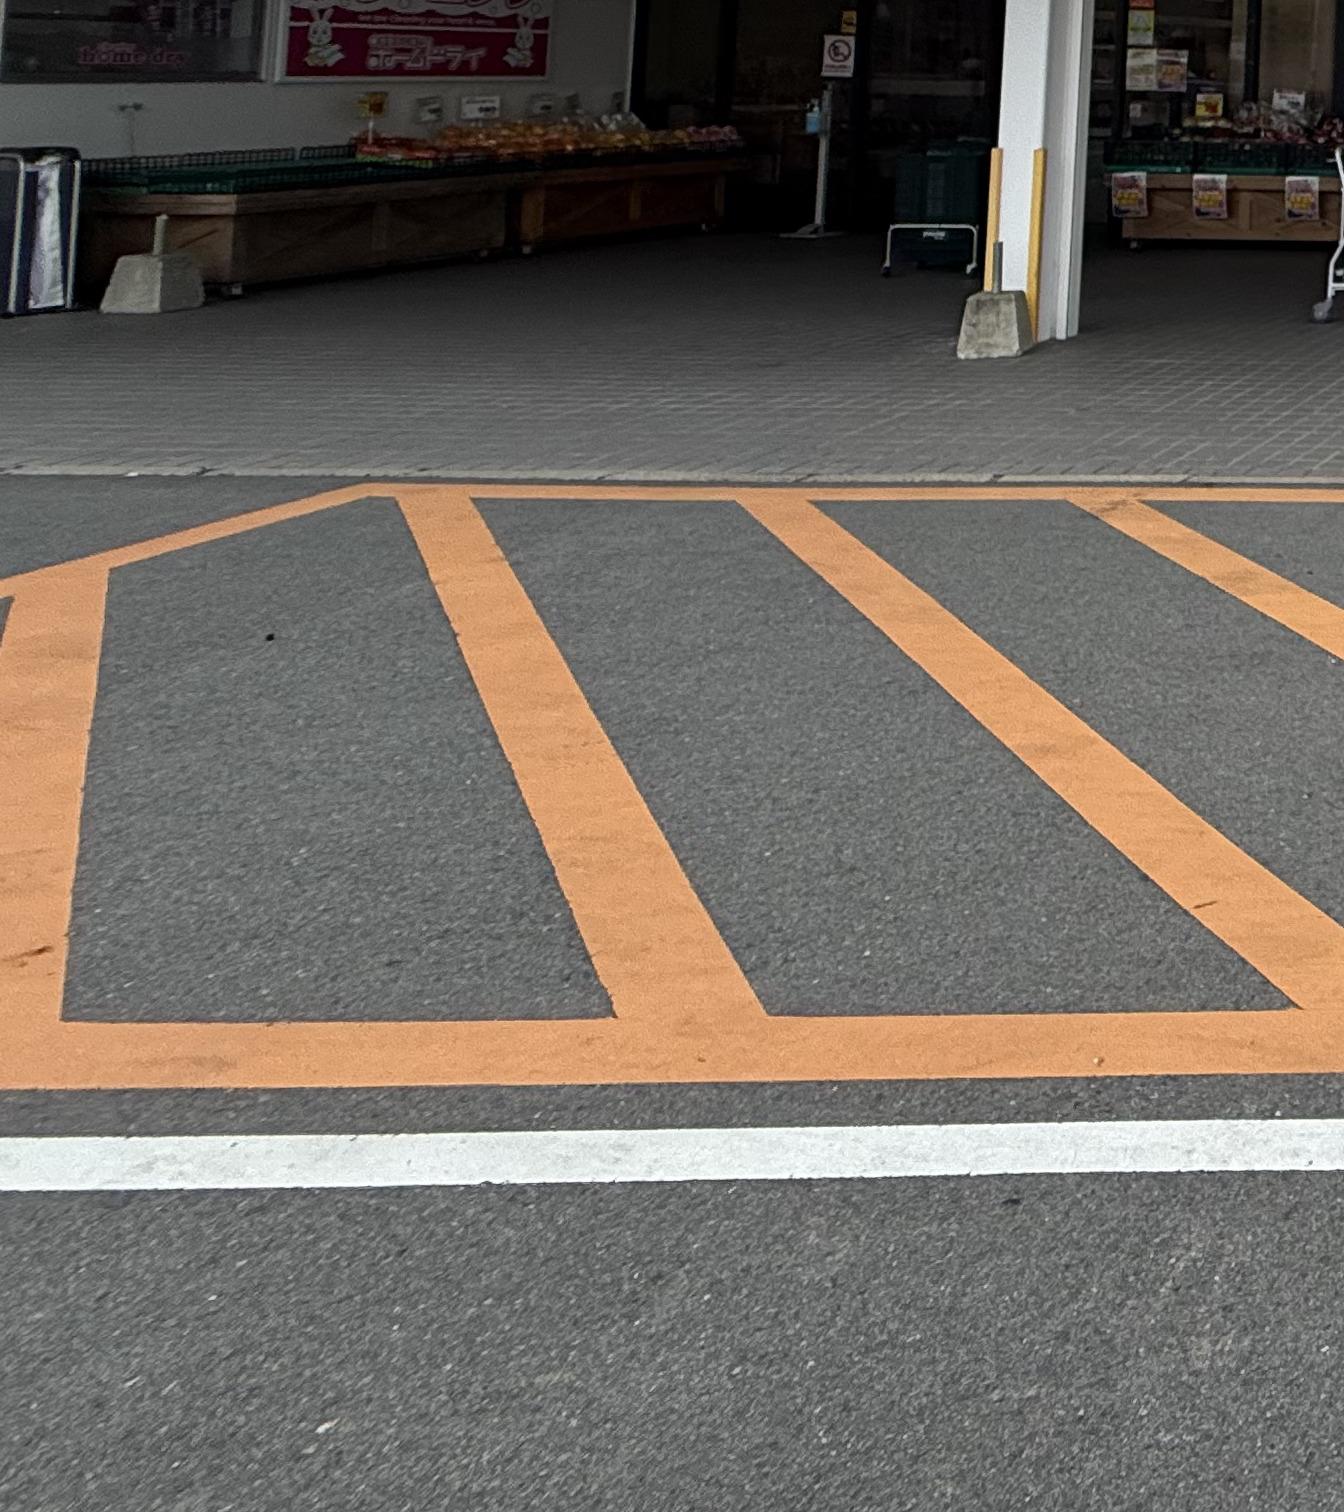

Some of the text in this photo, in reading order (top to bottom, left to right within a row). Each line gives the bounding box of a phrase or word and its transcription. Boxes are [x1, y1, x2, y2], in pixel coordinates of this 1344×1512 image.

[366, 43, 488, 72] ホームドライ
